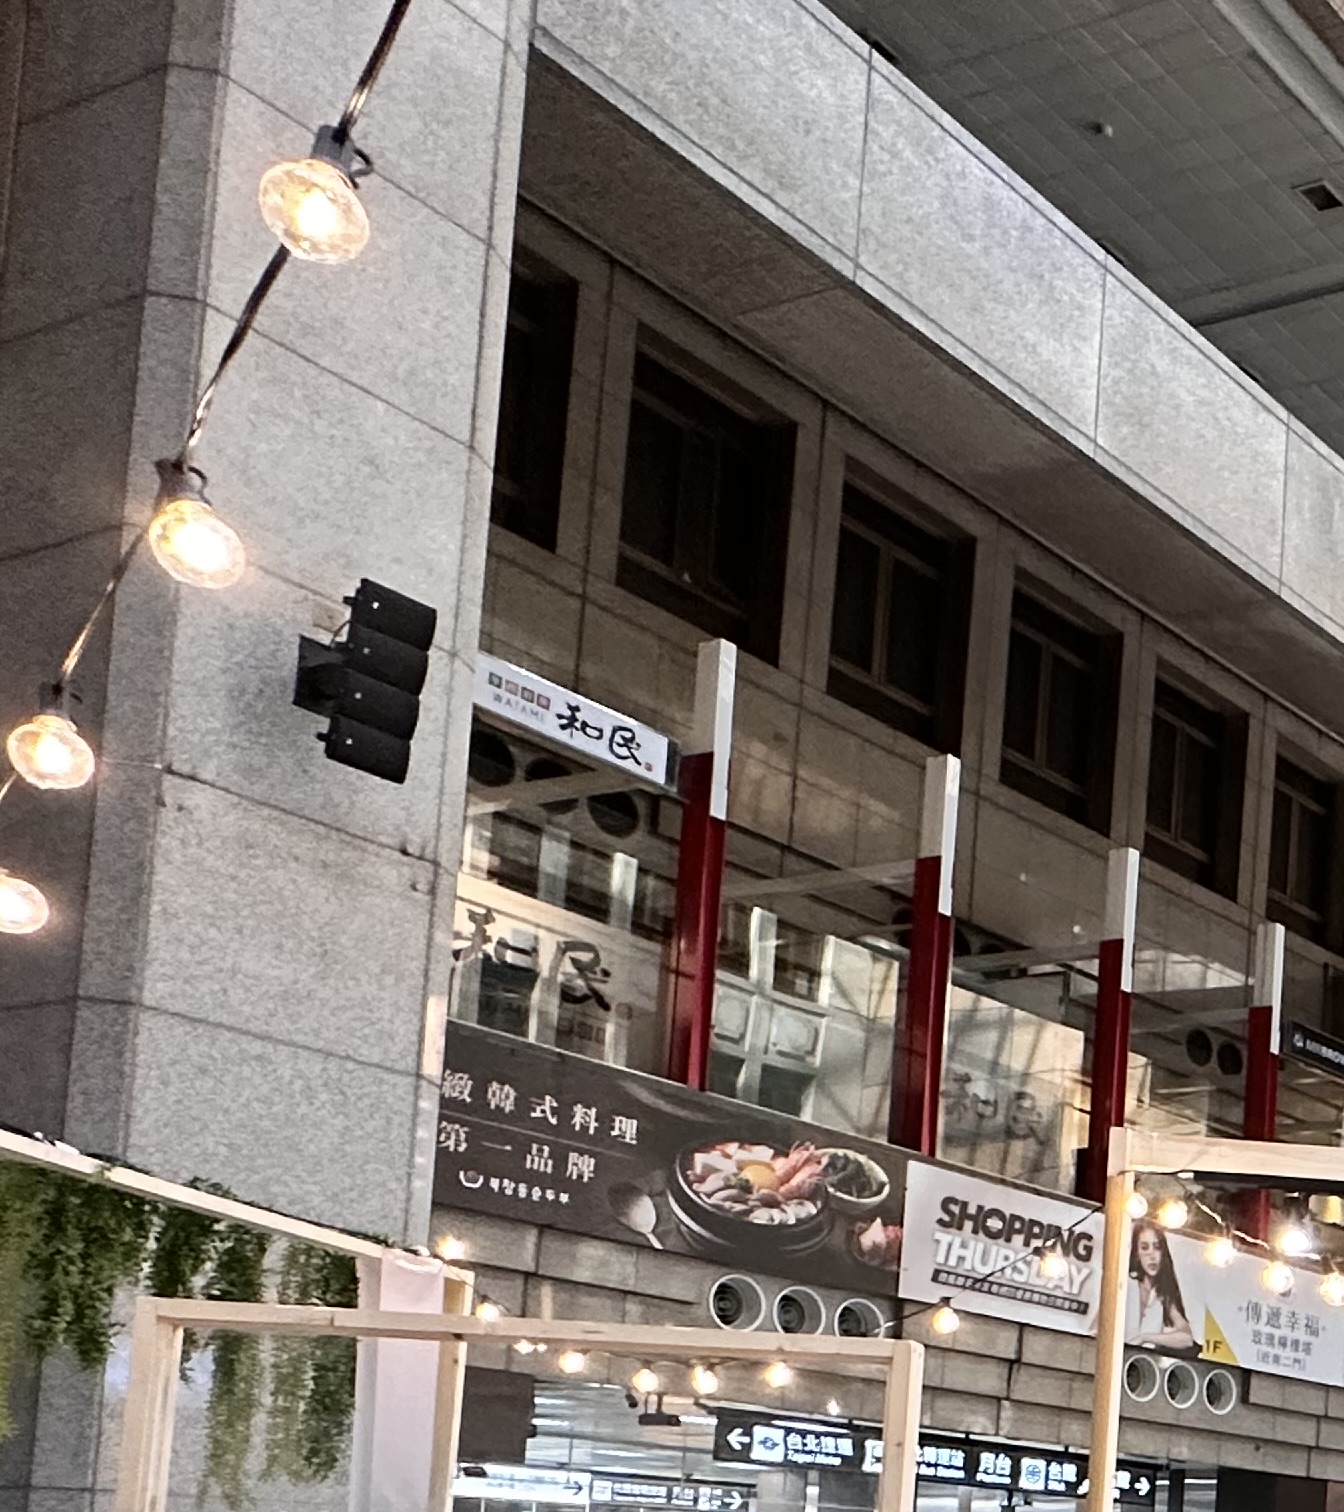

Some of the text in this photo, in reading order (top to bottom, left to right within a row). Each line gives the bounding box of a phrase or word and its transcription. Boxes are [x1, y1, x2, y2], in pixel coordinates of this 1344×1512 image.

[492, 692, 545, 723] WATAMI
[555, 700, 642, 767] 和民
[438, 1120, 597, 1184] 第一品牌
[936, 1195, 1094, 1262] SHOPPING
[1246, 1300, 1320, 1338] 傳遞幸福
